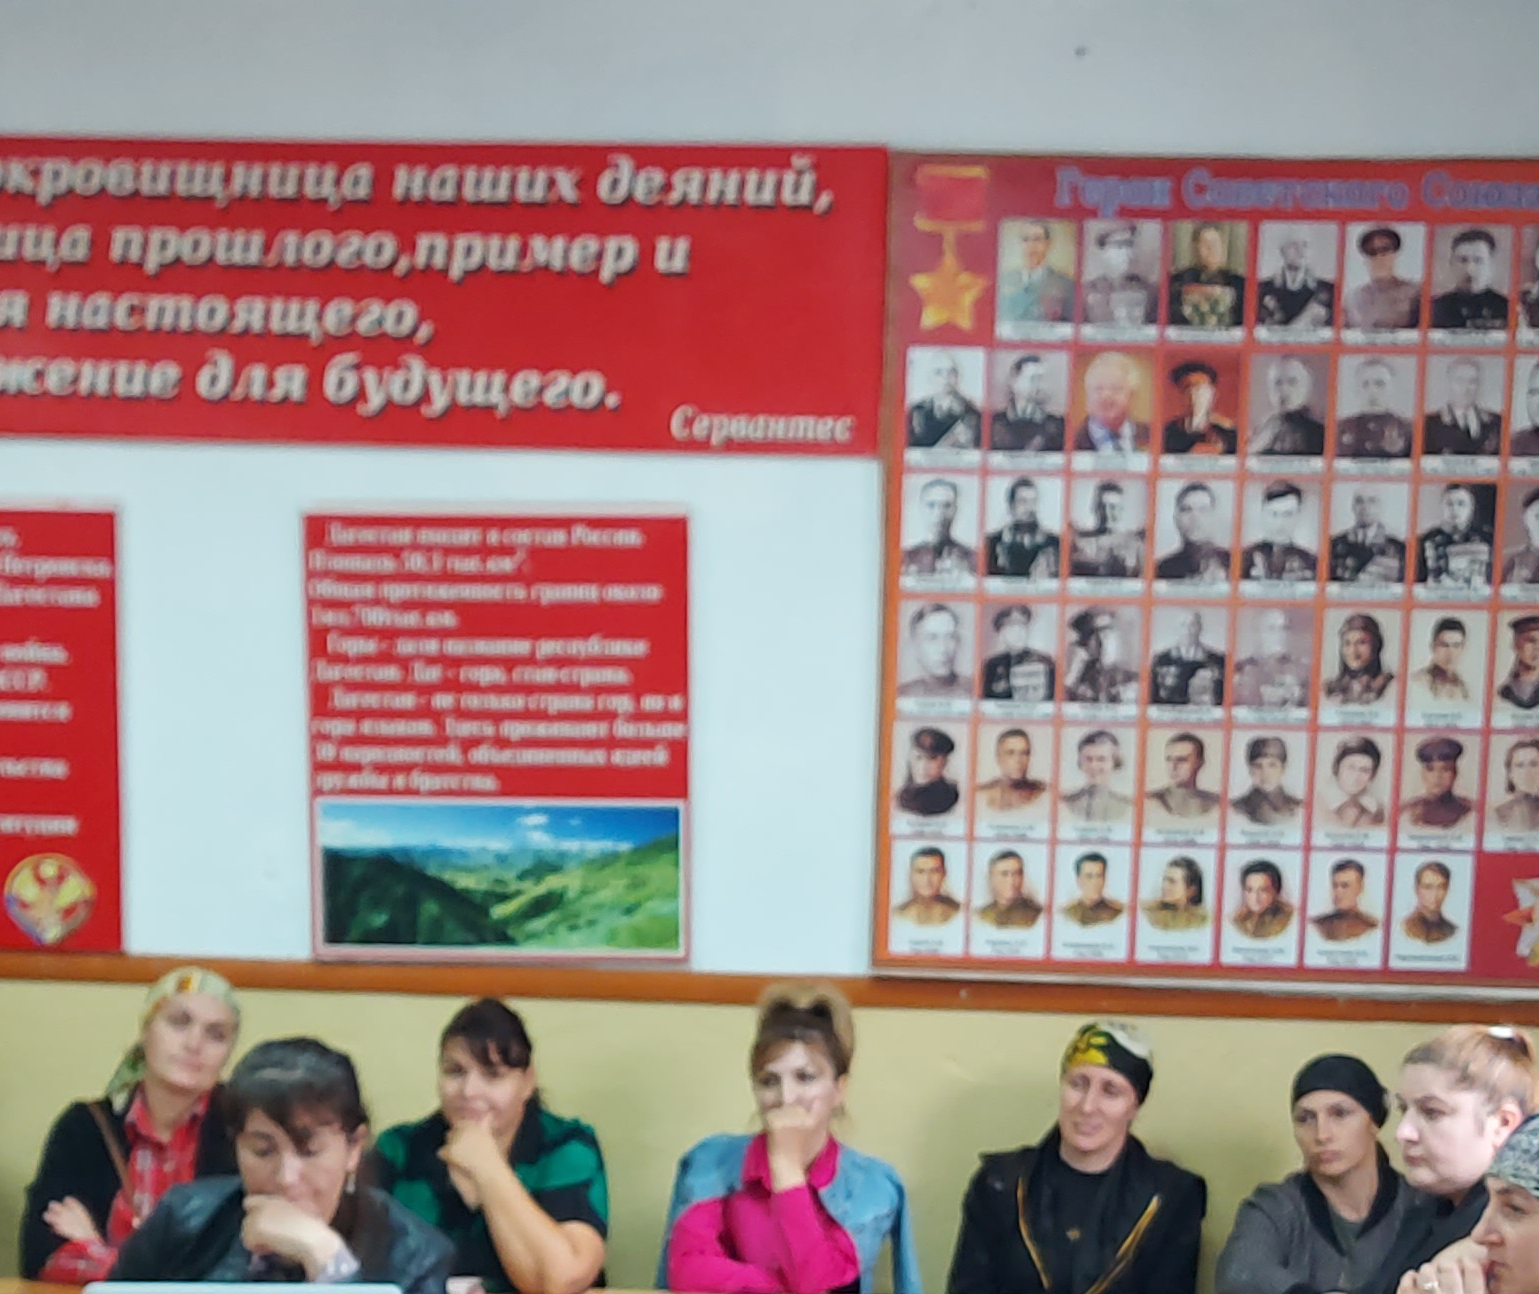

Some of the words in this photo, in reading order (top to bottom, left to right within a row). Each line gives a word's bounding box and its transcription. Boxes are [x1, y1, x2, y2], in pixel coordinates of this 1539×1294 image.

[393, 165, 578, 203] наших
[597, 154, 832, 214] деяний,
[1055, 165, 1172, 219] Герои
[1181, 167, 1410, 211] Советского
[654, 236, 690, 273] и
[45, 291, 433, 345] настоящего,
[196, 349, 308, 402] для
[323, 352, 620, 417] будущего.
[670, 405, 855, 449] Сервантес
